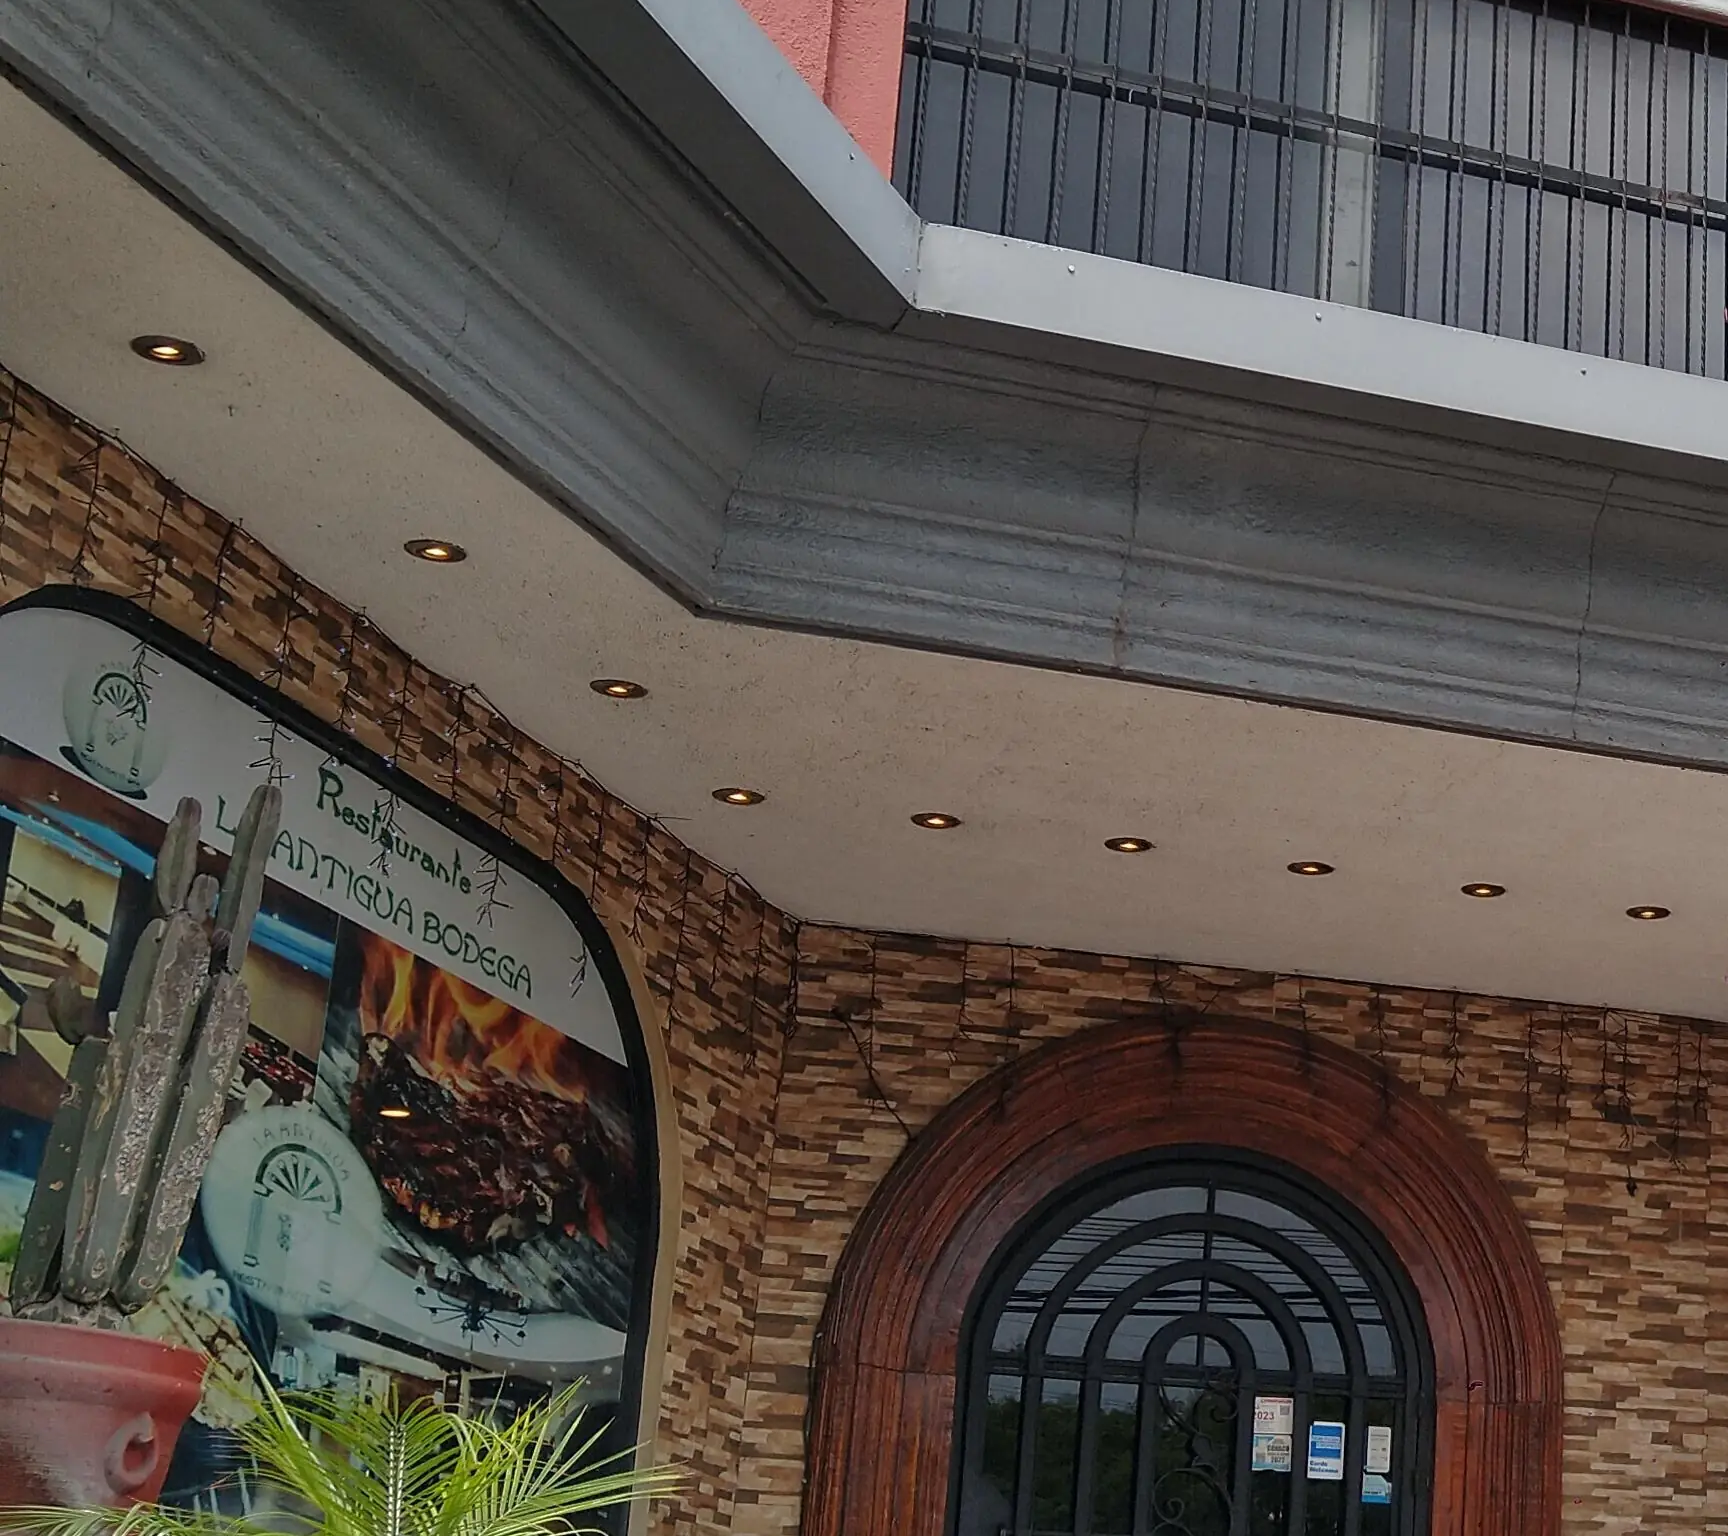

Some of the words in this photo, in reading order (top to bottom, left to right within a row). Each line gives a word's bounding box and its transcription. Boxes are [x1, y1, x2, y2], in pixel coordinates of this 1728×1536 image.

[317, 767, 472, 894] Restaurante
[271, 830, 413, 934] ANTIGUA
[422, 911, 532, 1000] BODEGA
